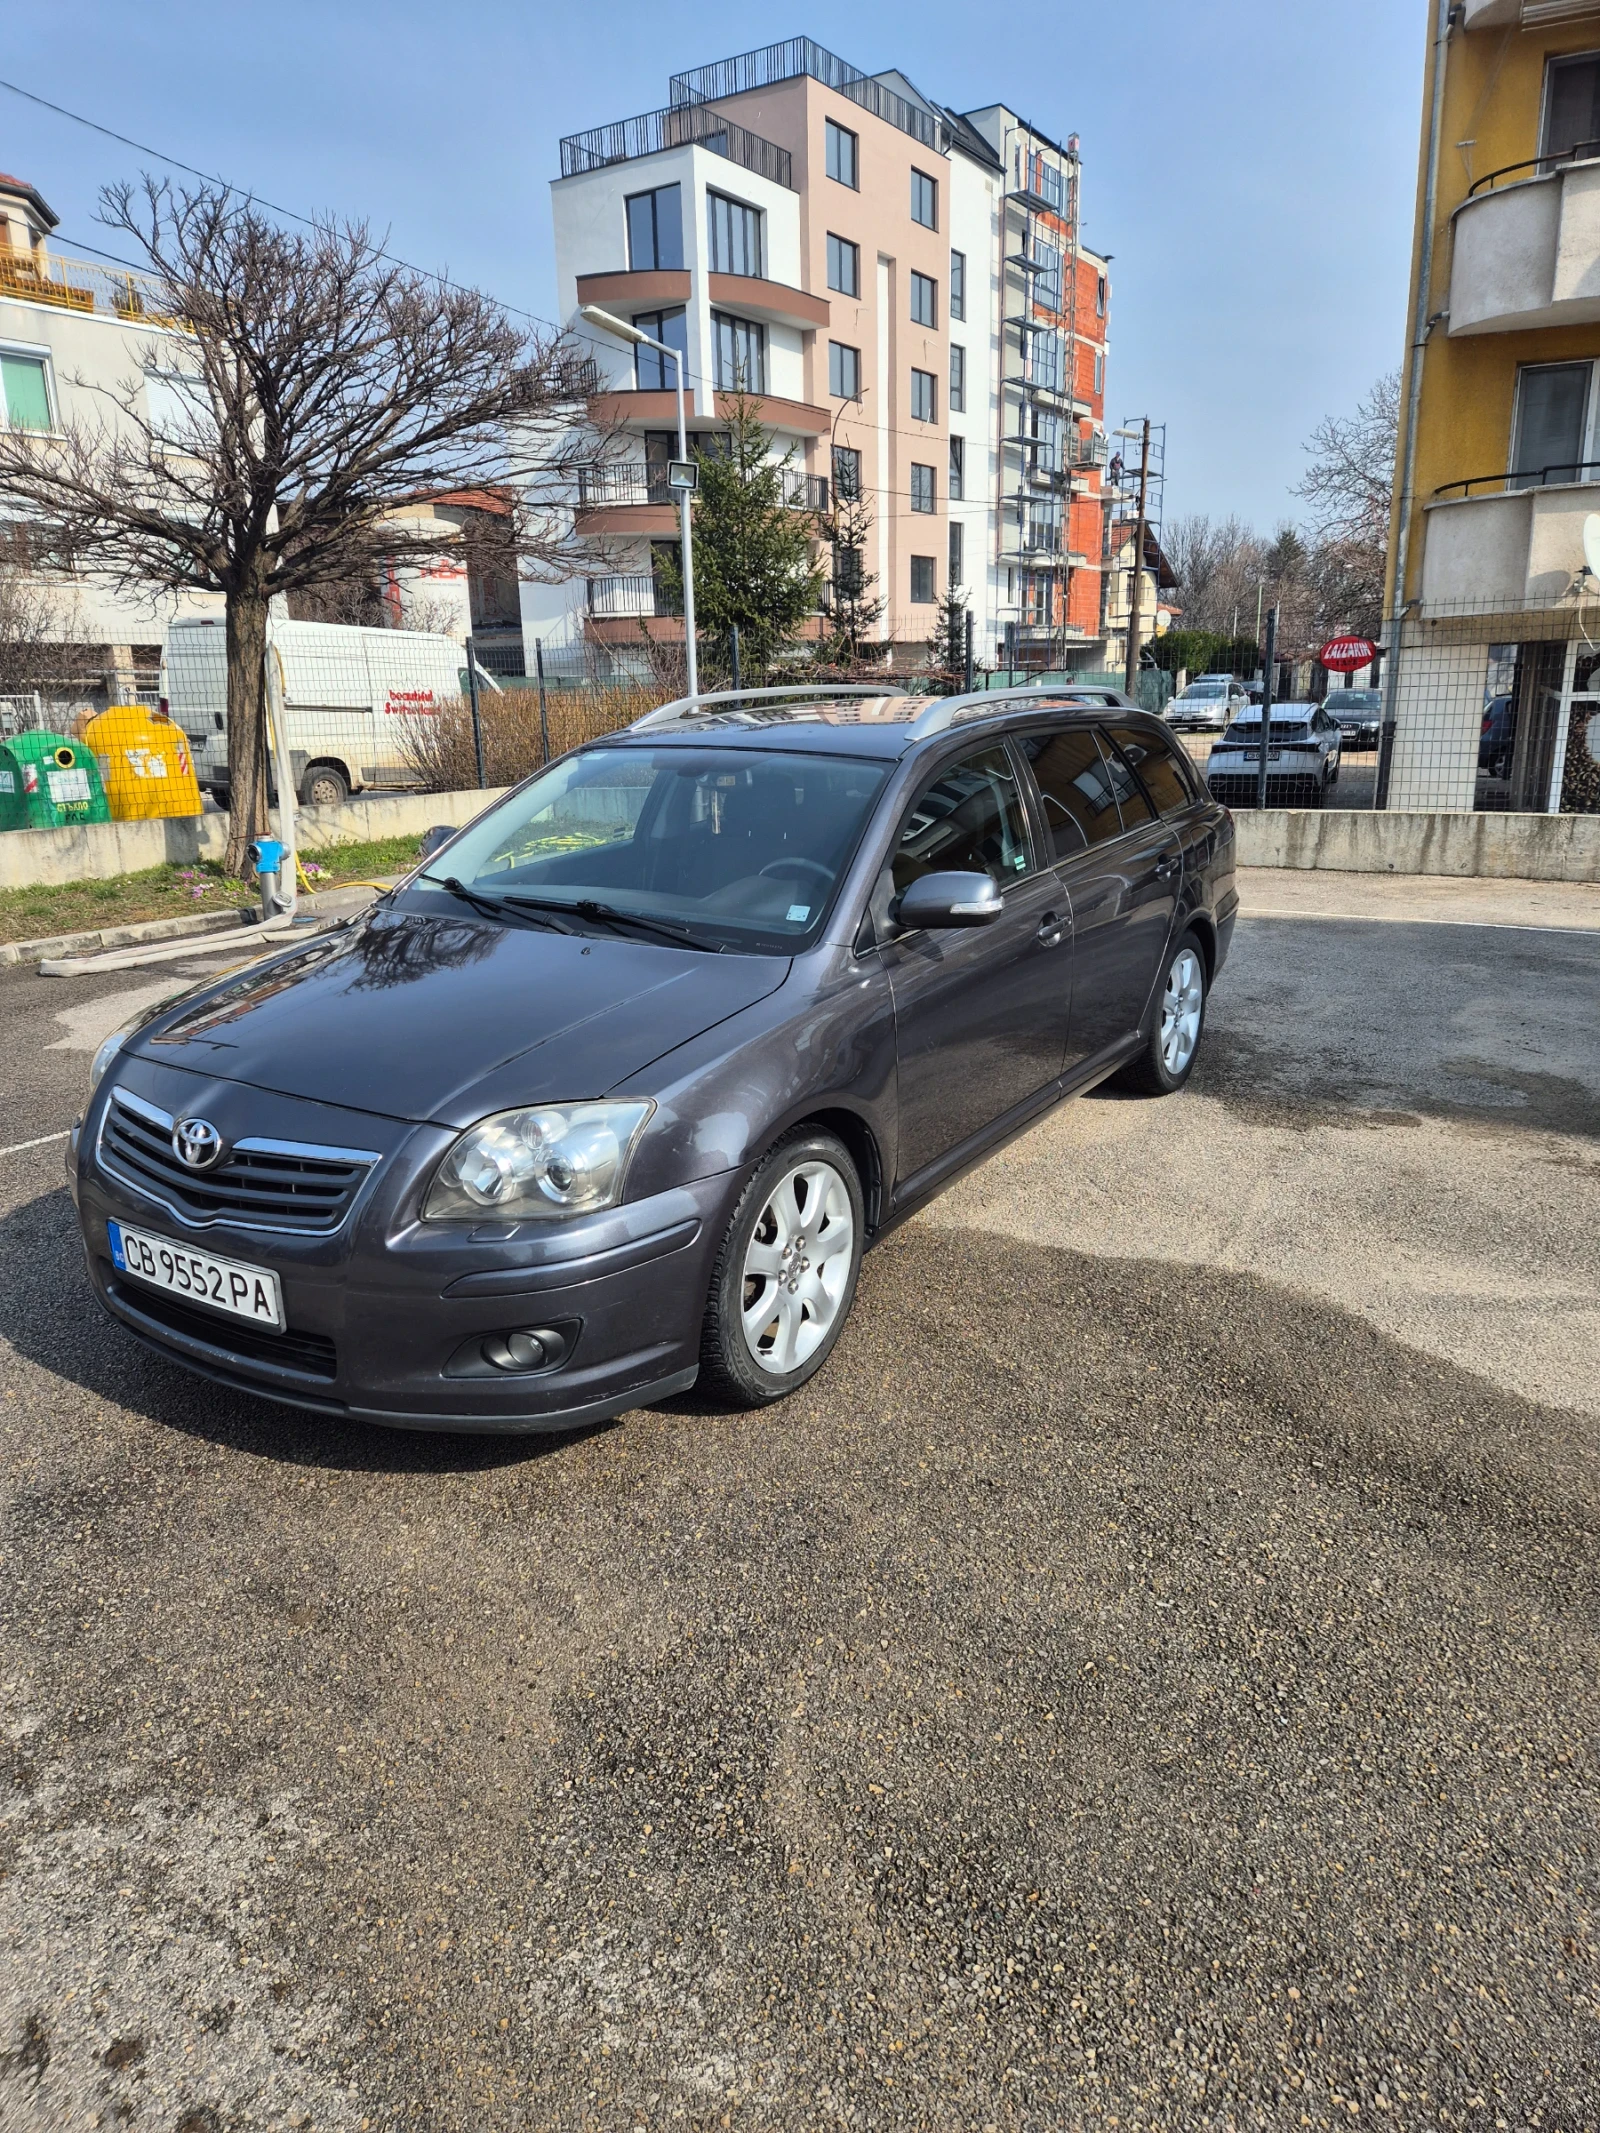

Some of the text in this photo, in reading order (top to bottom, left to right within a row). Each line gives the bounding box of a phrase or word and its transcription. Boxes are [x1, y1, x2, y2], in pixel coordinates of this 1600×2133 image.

[1323, 642, 1372, 660] LAZZARIN
[389, 689, 433, 701] beautiful
[124, 1235, 272, 1317] CB 9552 PA
